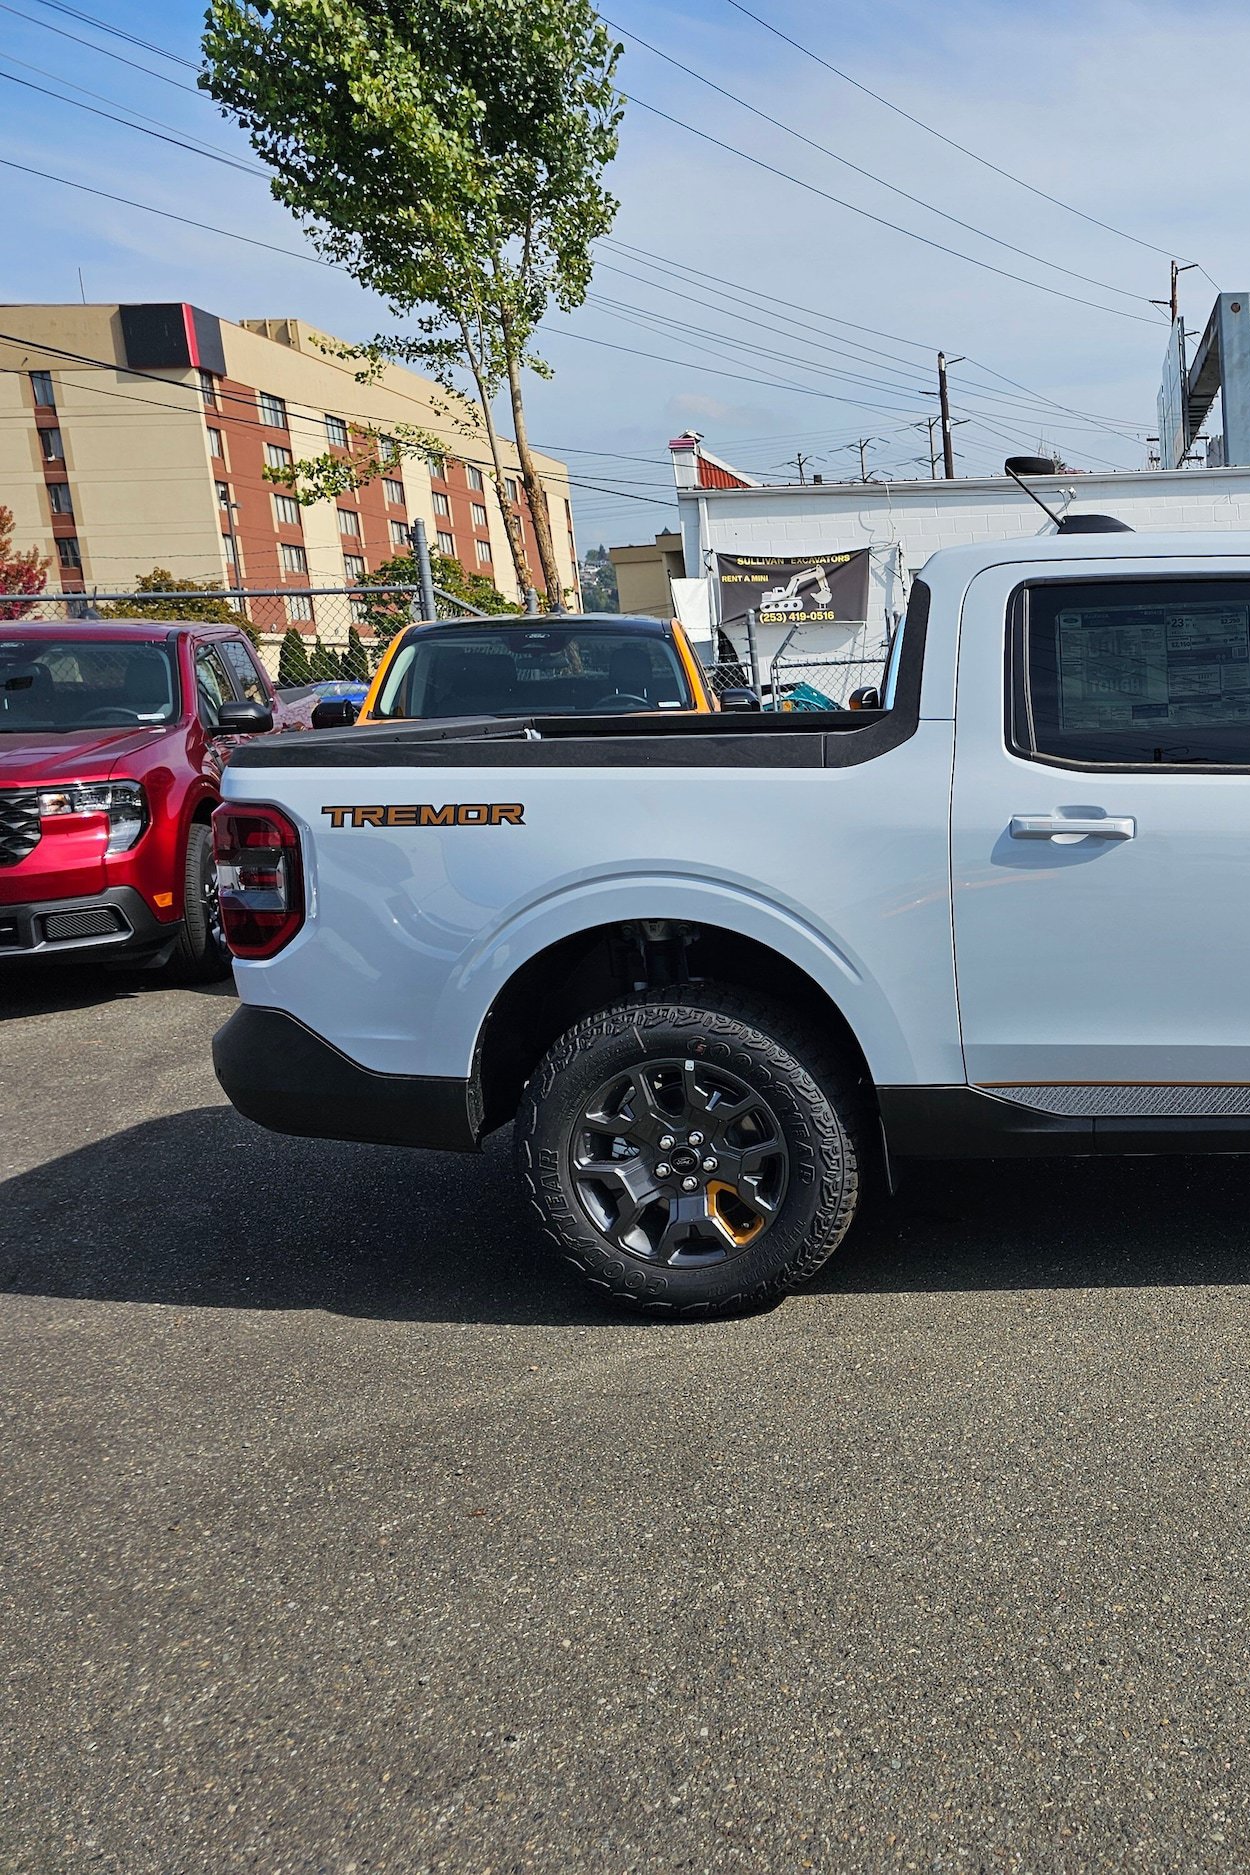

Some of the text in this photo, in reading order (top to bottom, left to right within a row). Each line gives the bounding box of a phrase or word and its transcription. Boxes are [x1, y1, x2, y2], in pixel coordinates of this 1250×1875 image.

[737, 554, 851, 566] SULLIVAN EXCAVATORS
[721, 575, 743, 583] RENT
[751, 574, 769, 582] MINI
[760, 610, 835, 624] (253) 419-0516
[1171, 618, 1184, 628] 23
[321, 803, 527, 828] TREMOR
